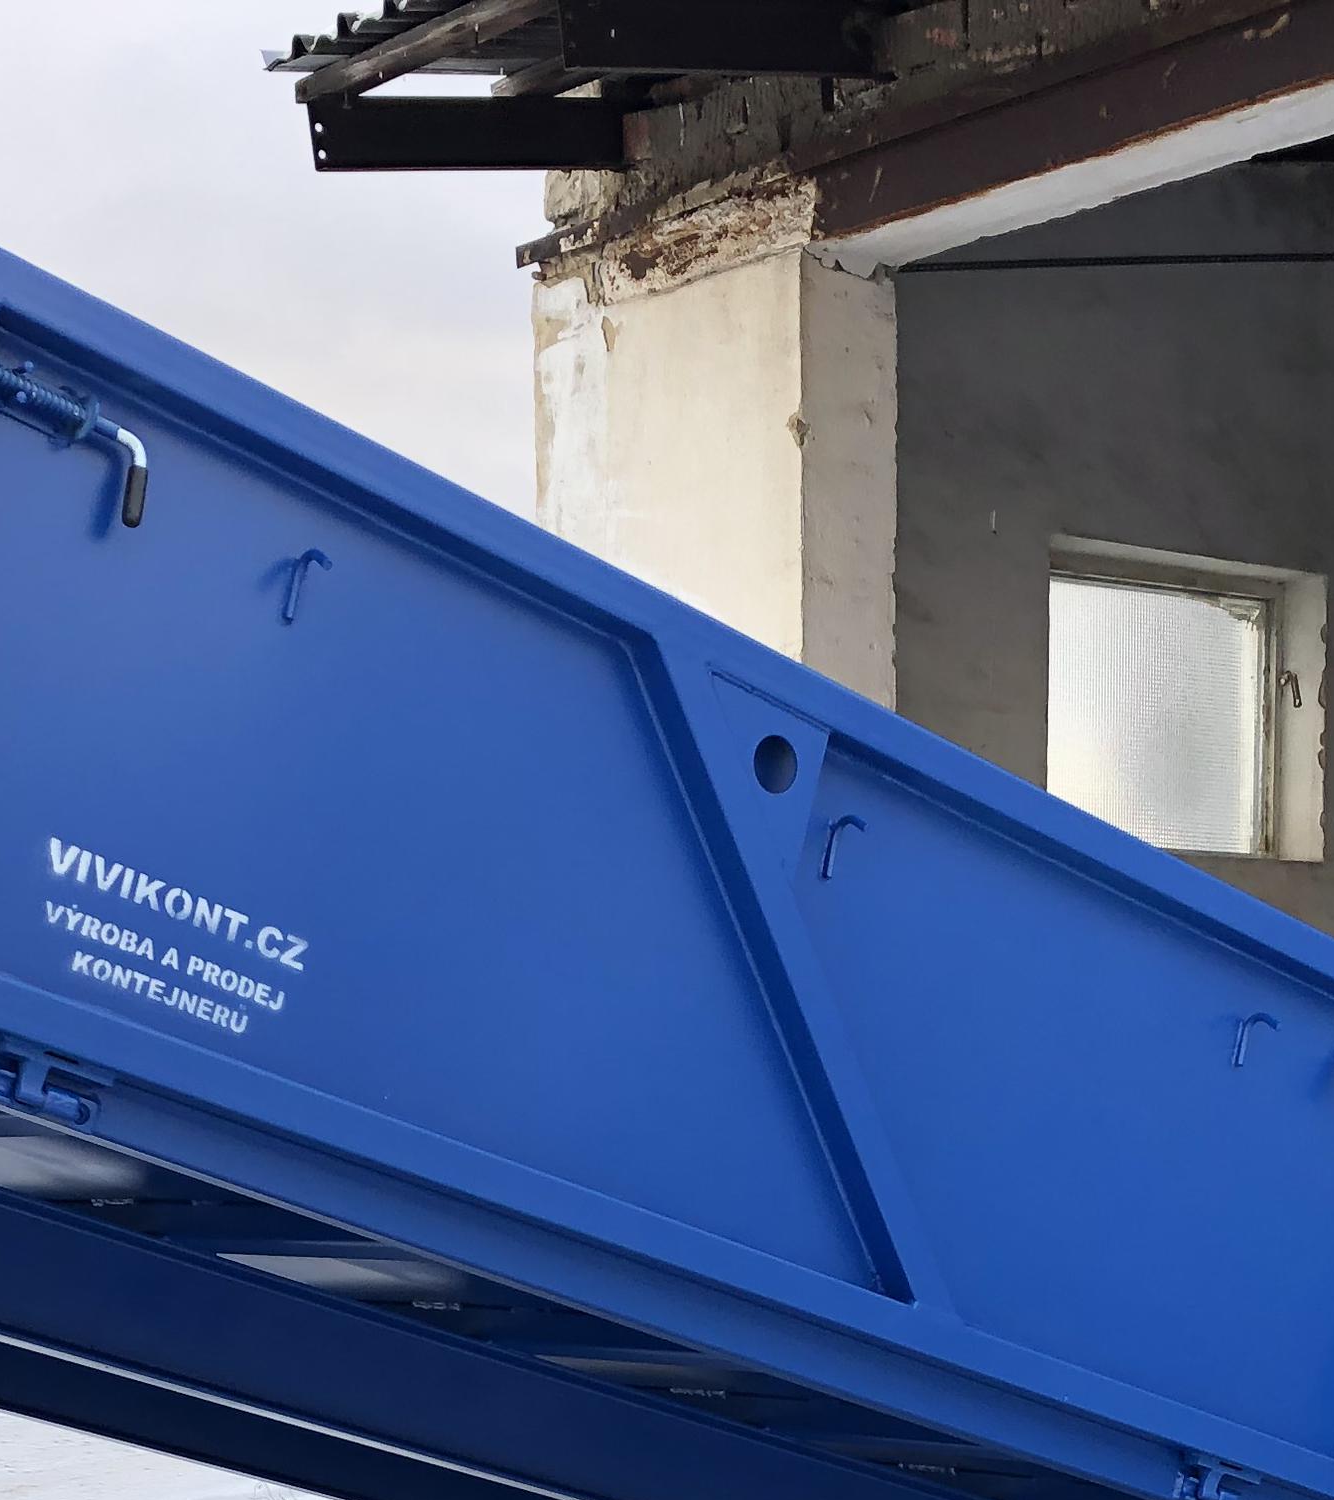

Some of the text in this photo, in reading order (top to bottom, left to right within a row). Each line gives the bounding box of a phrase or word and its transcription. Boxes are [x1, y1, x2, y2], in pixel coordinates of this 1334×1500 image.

[48, 836, 309, 971] VIVIKONT.CZ
[160, 947, 179, 971] A
[186, 955, 285, 1011] PRODEJ
